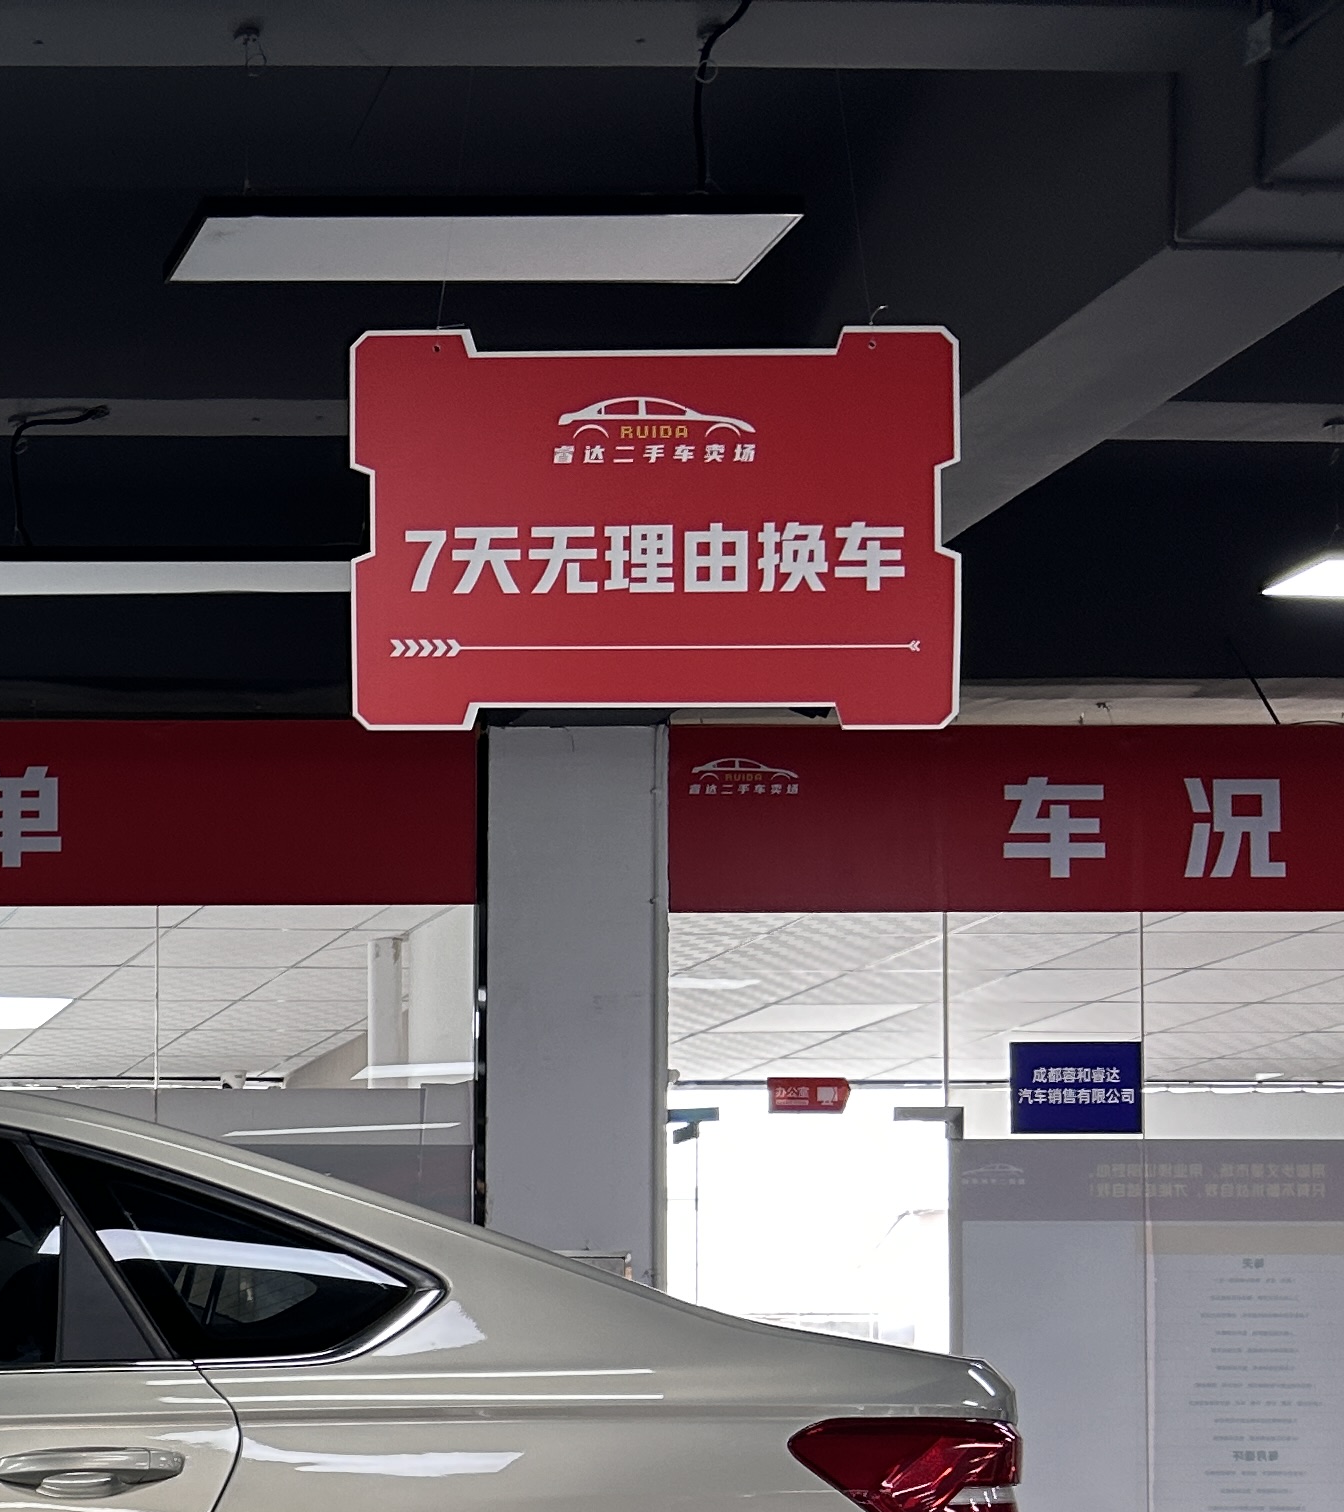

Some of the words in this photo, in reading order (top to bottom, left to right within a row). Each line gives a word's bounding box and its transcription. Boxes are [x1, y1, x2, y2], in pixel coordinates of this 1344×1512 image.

[620, 425, 689, 439] RUIDA
[553, 443, 756, 464] 睿达二手车卖场
[404, 521, 906, 595] 7天无理由换车
[1002, 776, 1287, 879] 车况
[775, 1086, 810, 1098] 办公室
[1017, 1087, 1135, 1105] 汽车销售有限公司
